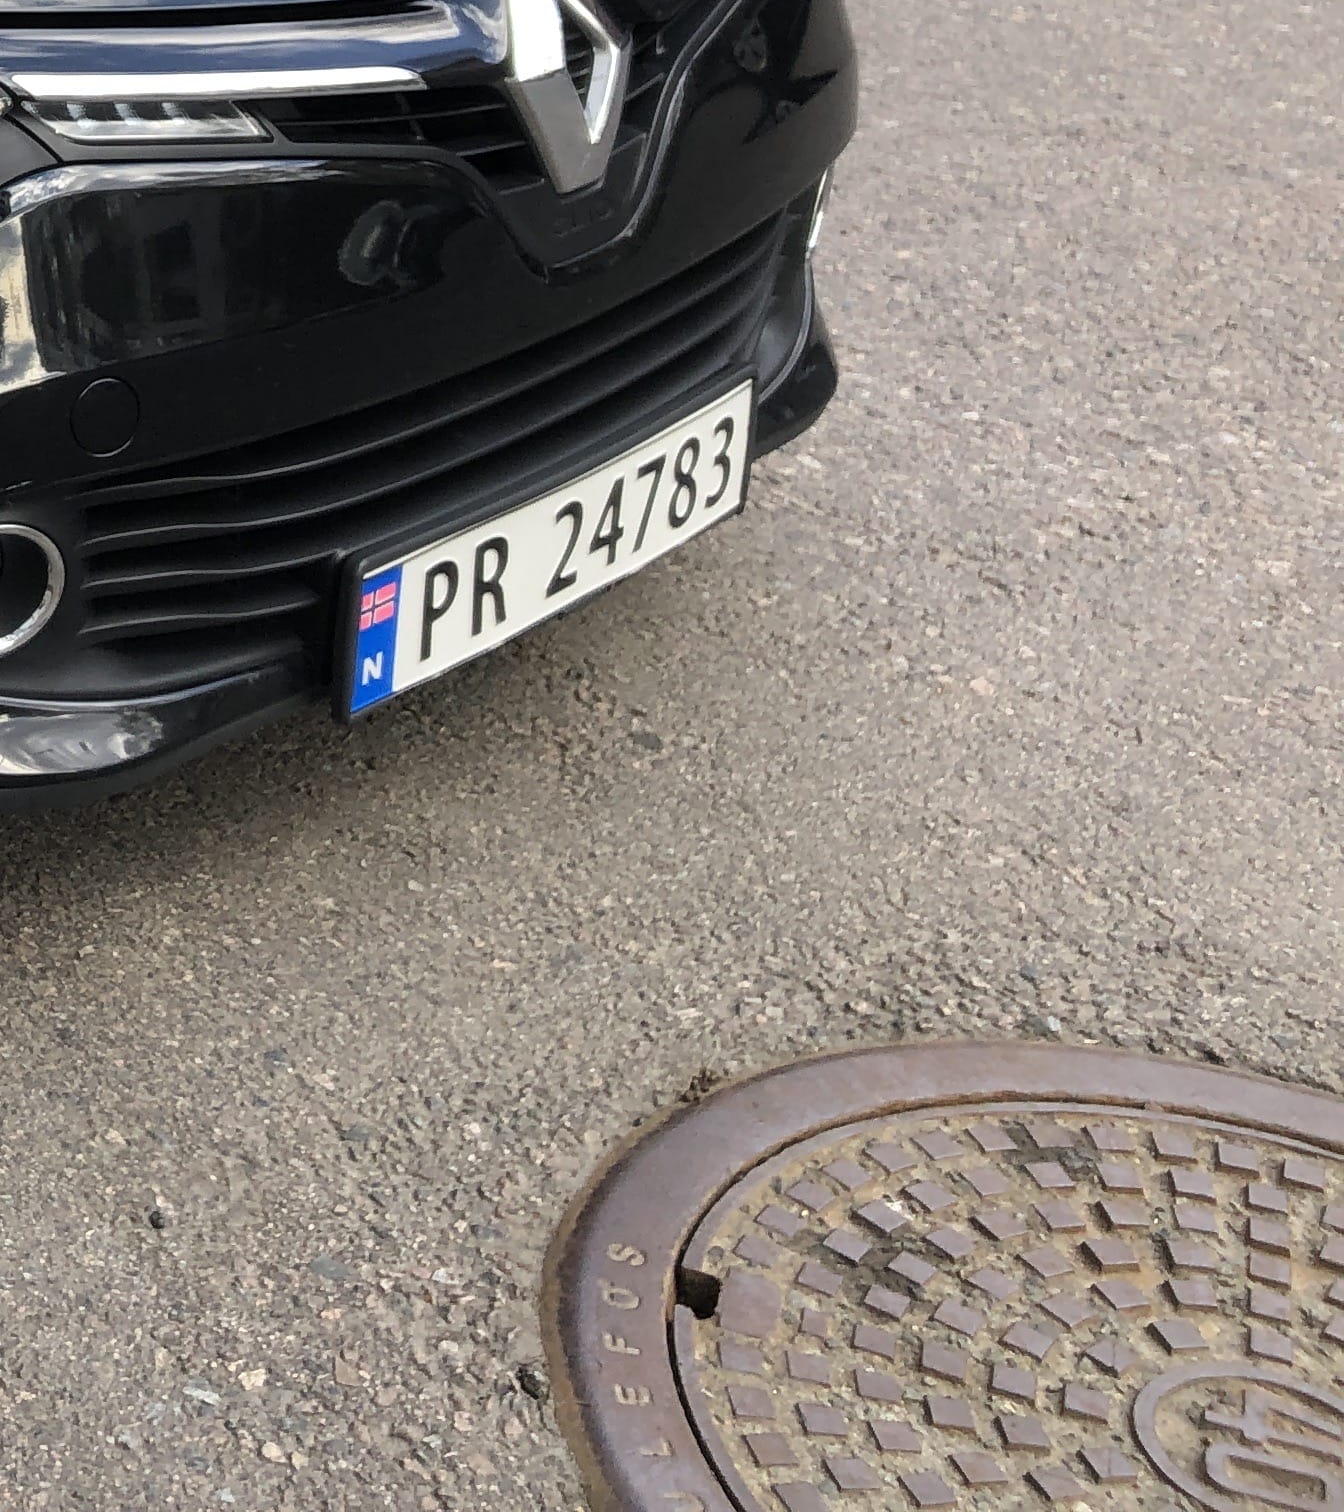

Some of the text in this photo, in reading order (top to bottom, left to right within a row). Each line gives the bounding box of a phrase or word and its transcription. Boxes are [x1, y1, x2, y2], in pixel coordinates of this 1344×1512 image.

[419, 416, 736, 662] PR 24783
[362, 651, 383, 686] N
